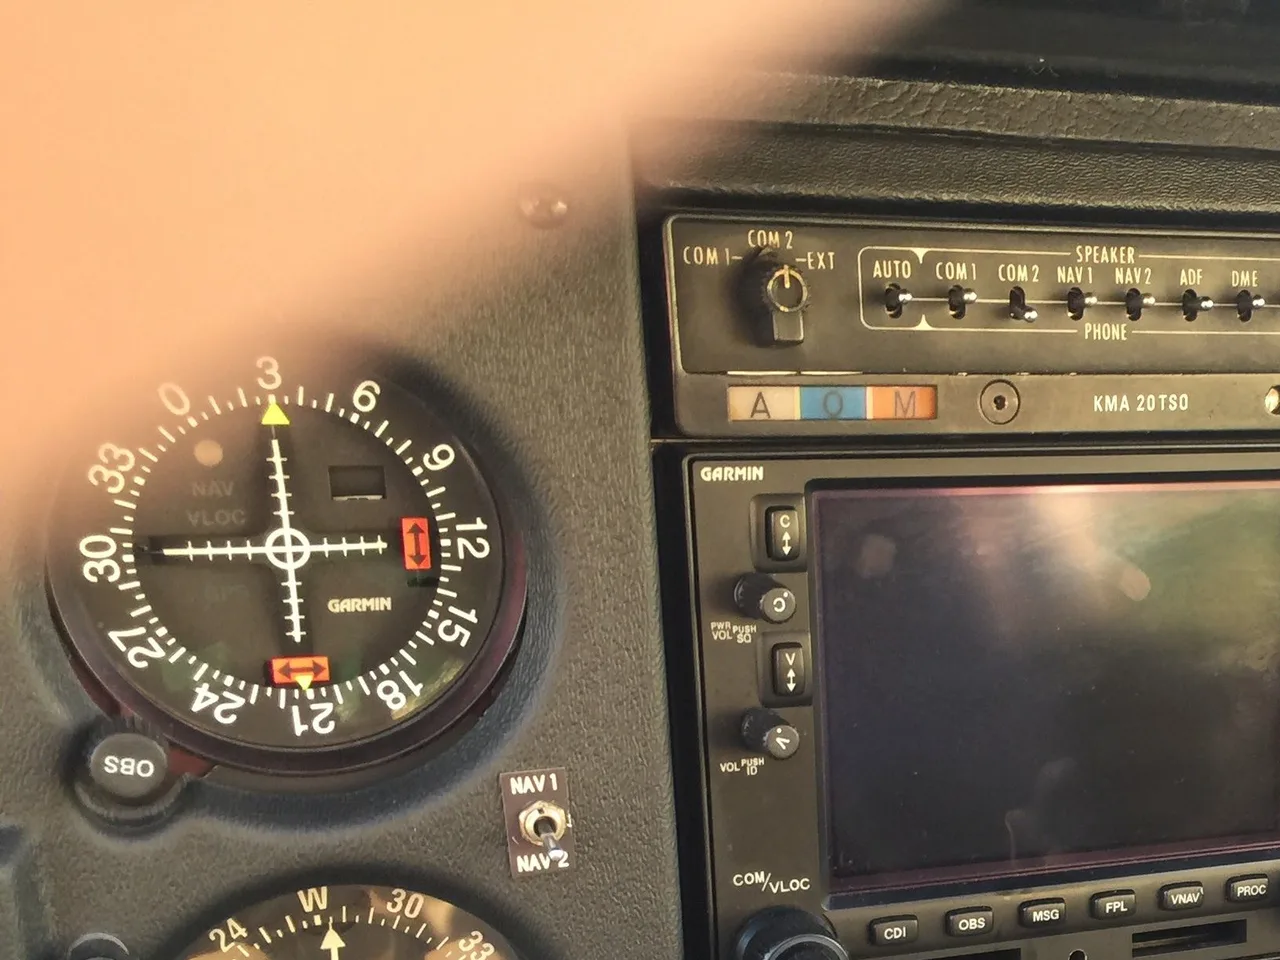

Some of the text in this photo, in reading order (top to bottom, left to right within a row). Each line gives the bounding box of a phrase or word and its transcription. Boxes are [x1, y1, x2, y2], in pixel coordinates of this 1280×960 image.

[807, 252, 835, 270] EXT
[1076, 245, 1135, 264] SPEAKER
[873, 260, 911, 279] AUTO
[1180, 268, 1203, 286] ADF
[1231, 270, 1259, 287] DME
[1084, 323, 1128, 341] PHONE
[700, 466, 764, 482] GARMIN
[457, 517, 490, 559] 12
[80, 534, 121, 584] 30
[327, 596, 392, 612] GARMIN
[436, 605, 479, 648] 15
[103, 754, 155, 779] OBS
[1236, 882, 1267, 898] PROC
[386, 887, 424, 918] 30
[1105, 900, 1128, 914] FPL
[958, 917, 986, 931] OBS
[1032, 907, 1060, 923] MSG
[209, 918, 248, 953] 24
[883, 925, 907, 939] CDI
